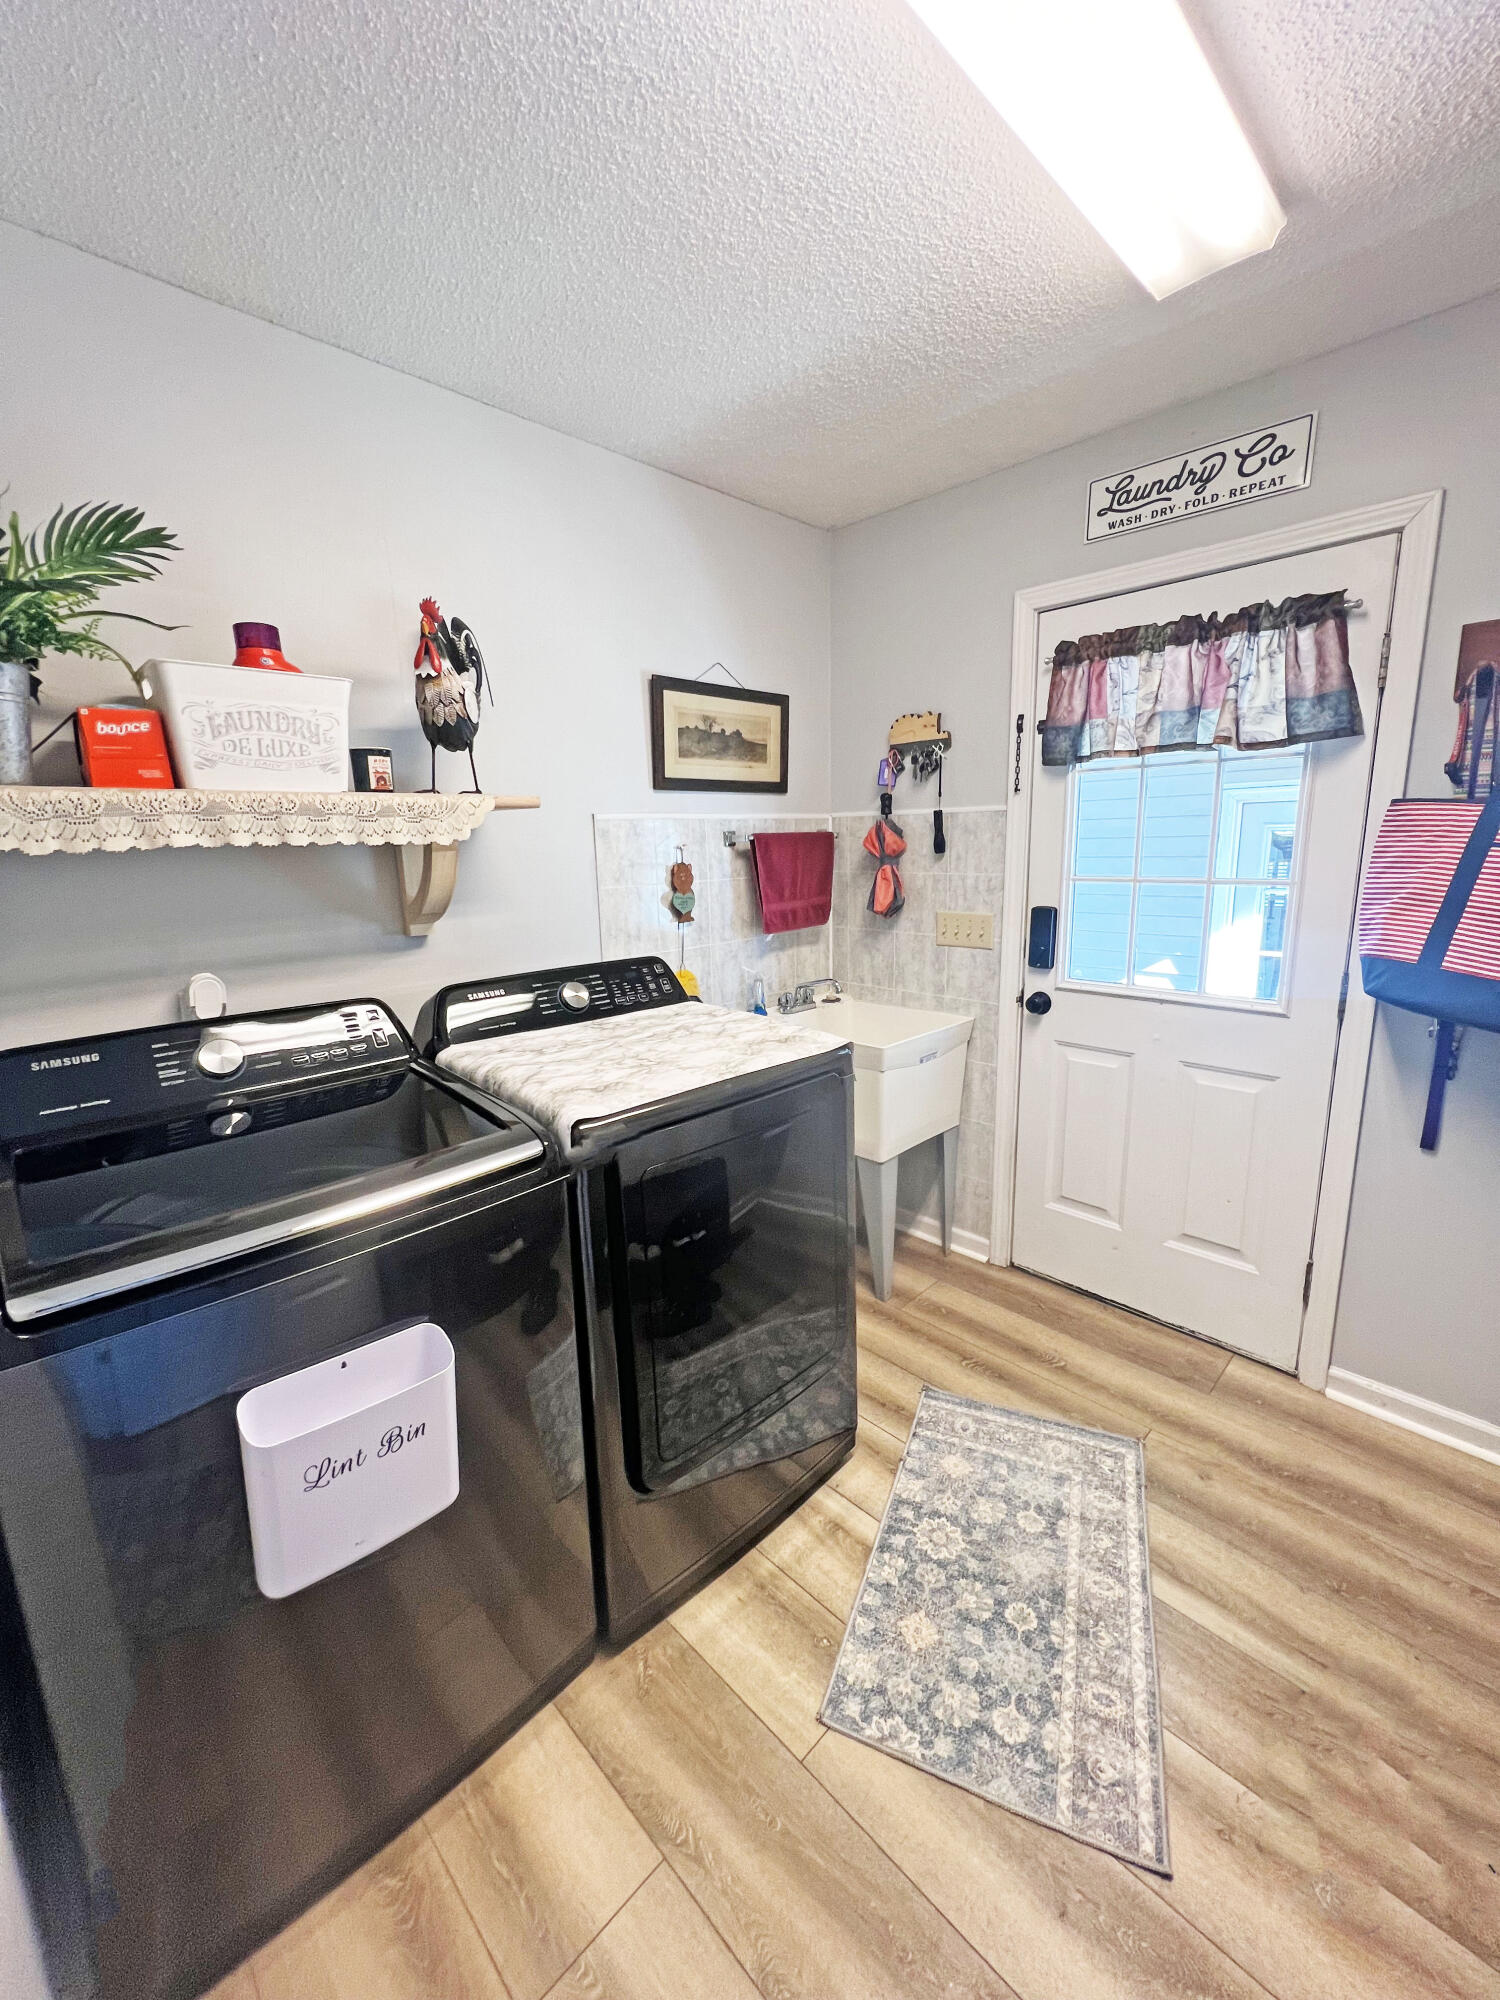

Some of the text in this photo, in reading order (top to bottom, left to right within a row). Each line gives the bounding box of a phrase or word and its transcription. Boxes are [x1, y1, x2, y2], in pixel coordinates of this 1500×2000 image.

[1097, 433, 1296, 517] Laundry Co
[1108, 474, 1287, 530] WASH DRY FOLD REPEAT
[96, 720, 150, 735] bounce
[207, 710, 321, 746] LAUNDRY
[222, 737, 312, 758] DE LUXE
[467, 988, 506, 1001] SAMSUNG
[30, 1053, 100, 1071] SAMSUNG
[303, 1421, 426, 1492] Lint Bin
